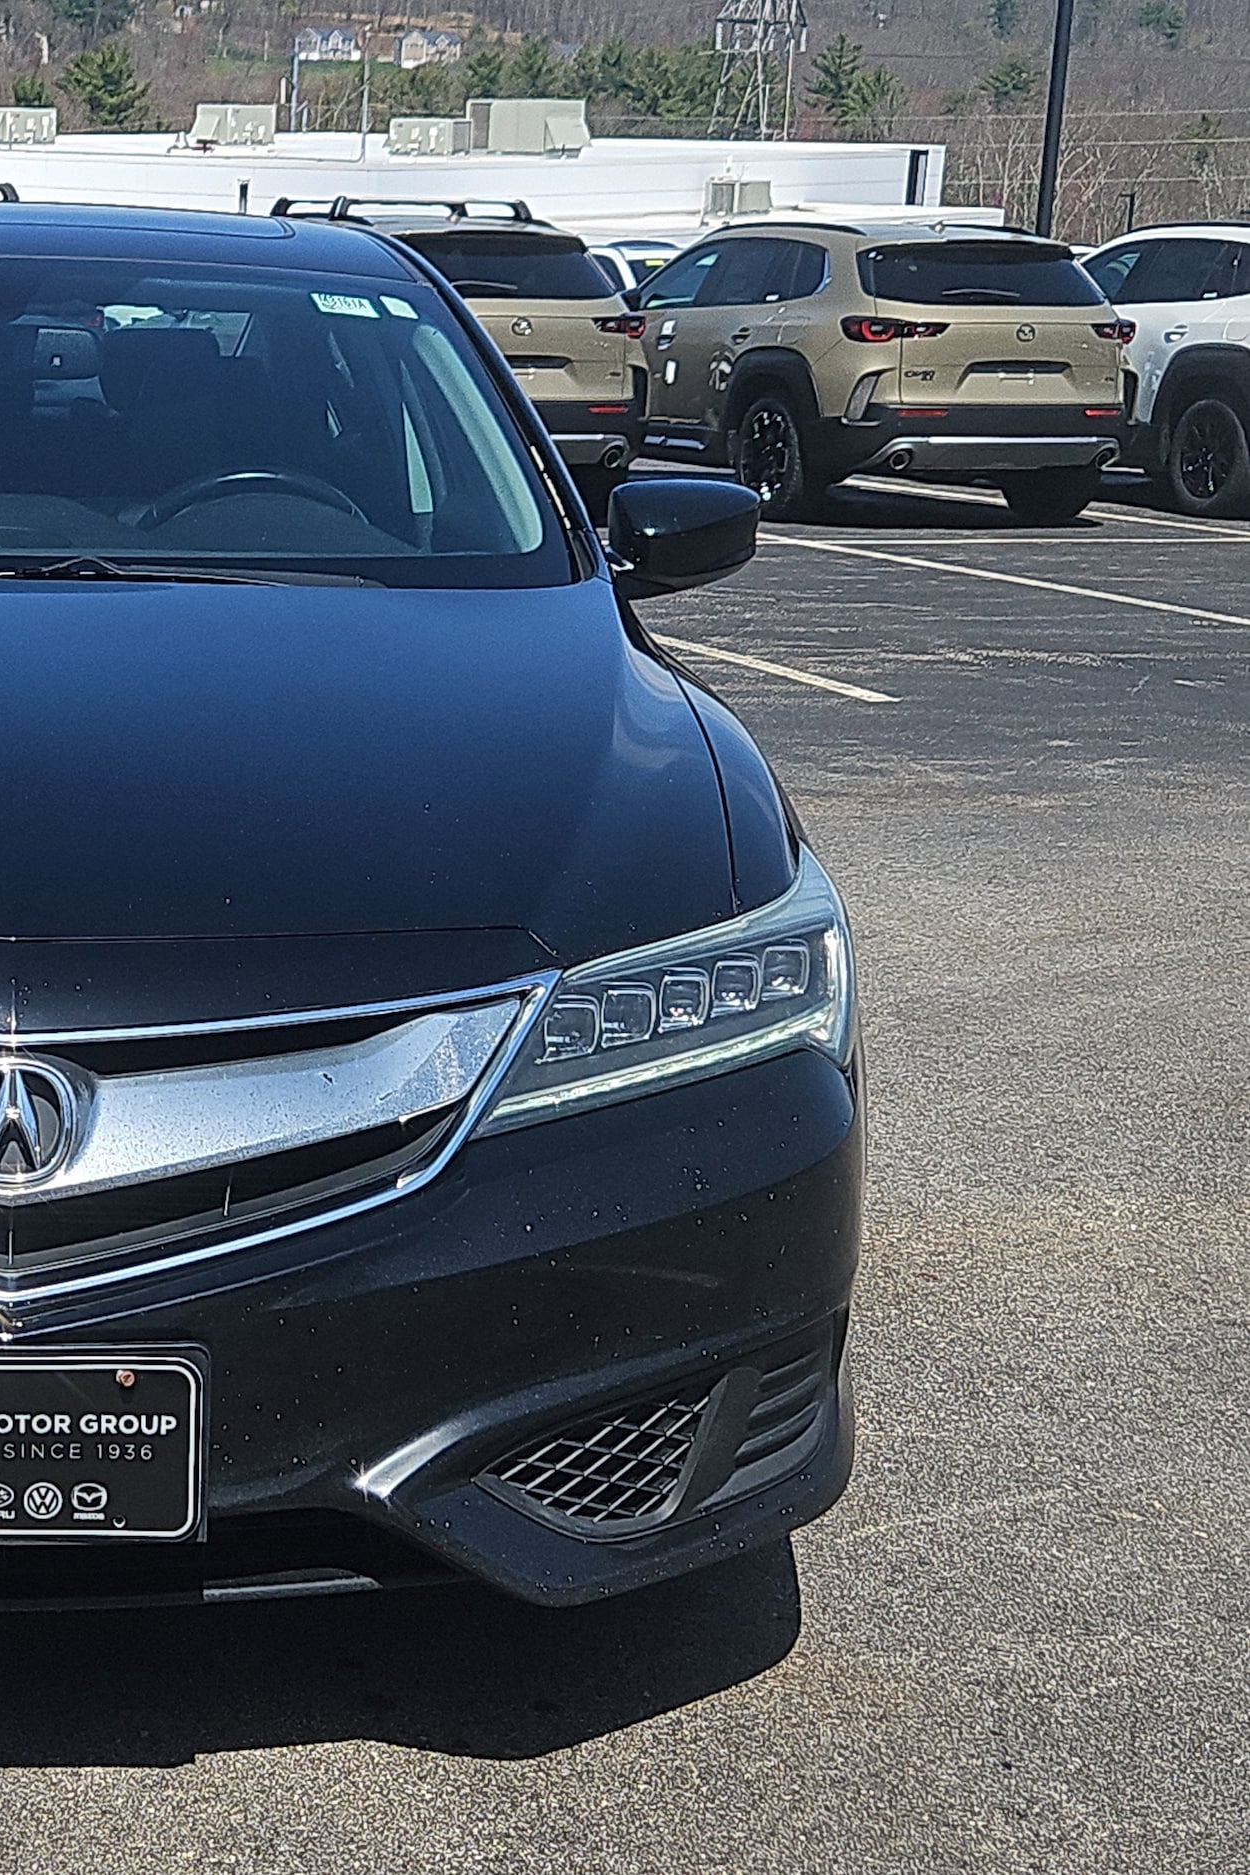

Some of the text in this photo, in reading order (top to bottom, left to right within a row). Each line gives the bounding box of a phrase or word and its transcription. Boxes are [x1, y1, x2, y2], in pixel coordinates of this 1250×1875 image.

[79, 1413, 177, 1435] GROUP
[3, 1443, 82, 1459] SINCE
[96, 1443, 153, 1460] 1936
